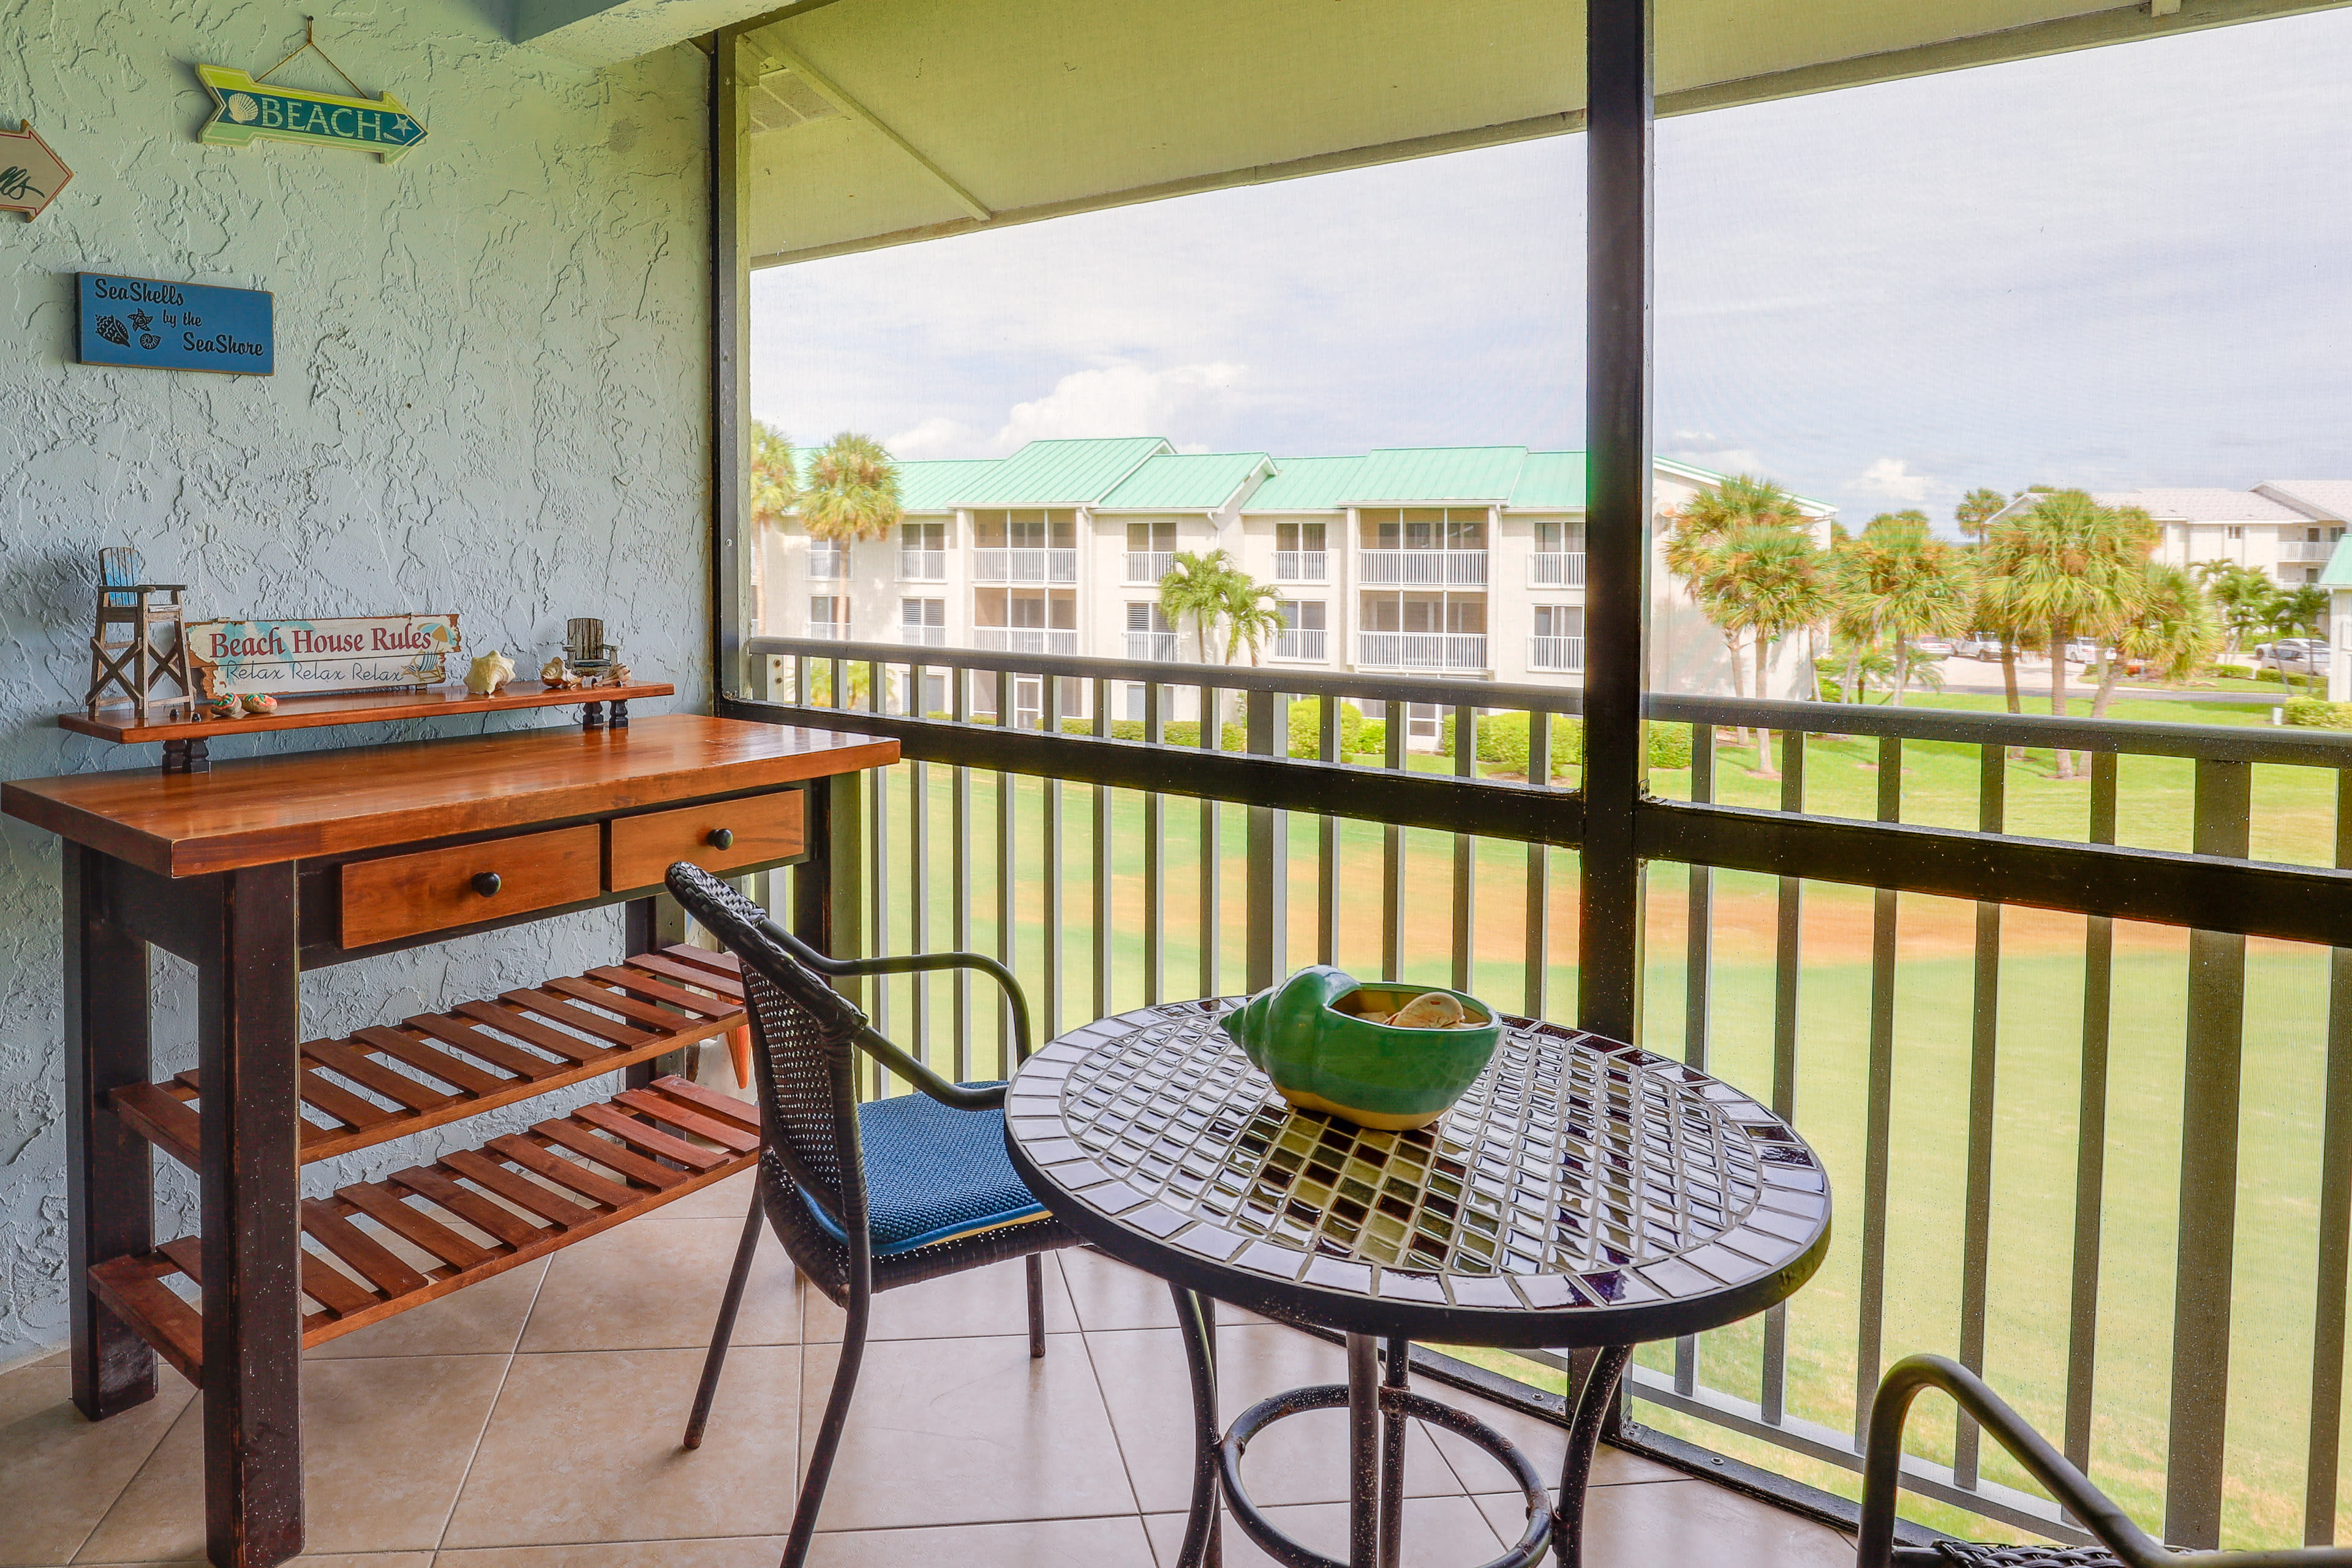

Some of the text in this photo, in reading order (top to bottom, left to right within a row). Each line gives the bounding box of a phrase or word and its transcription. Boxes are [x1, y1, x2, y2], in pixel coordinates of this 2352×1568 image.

[260, 97, 382, 141] BEACH
[94, 278, 184, 306] SeaShells
[162, 309, 202, 328] by the
[183, 331, 263, 356] SeaShore
[209, 623, 431, 658] Beach House Rules
[226, 660, 404, 682] Relax Relax Relax
